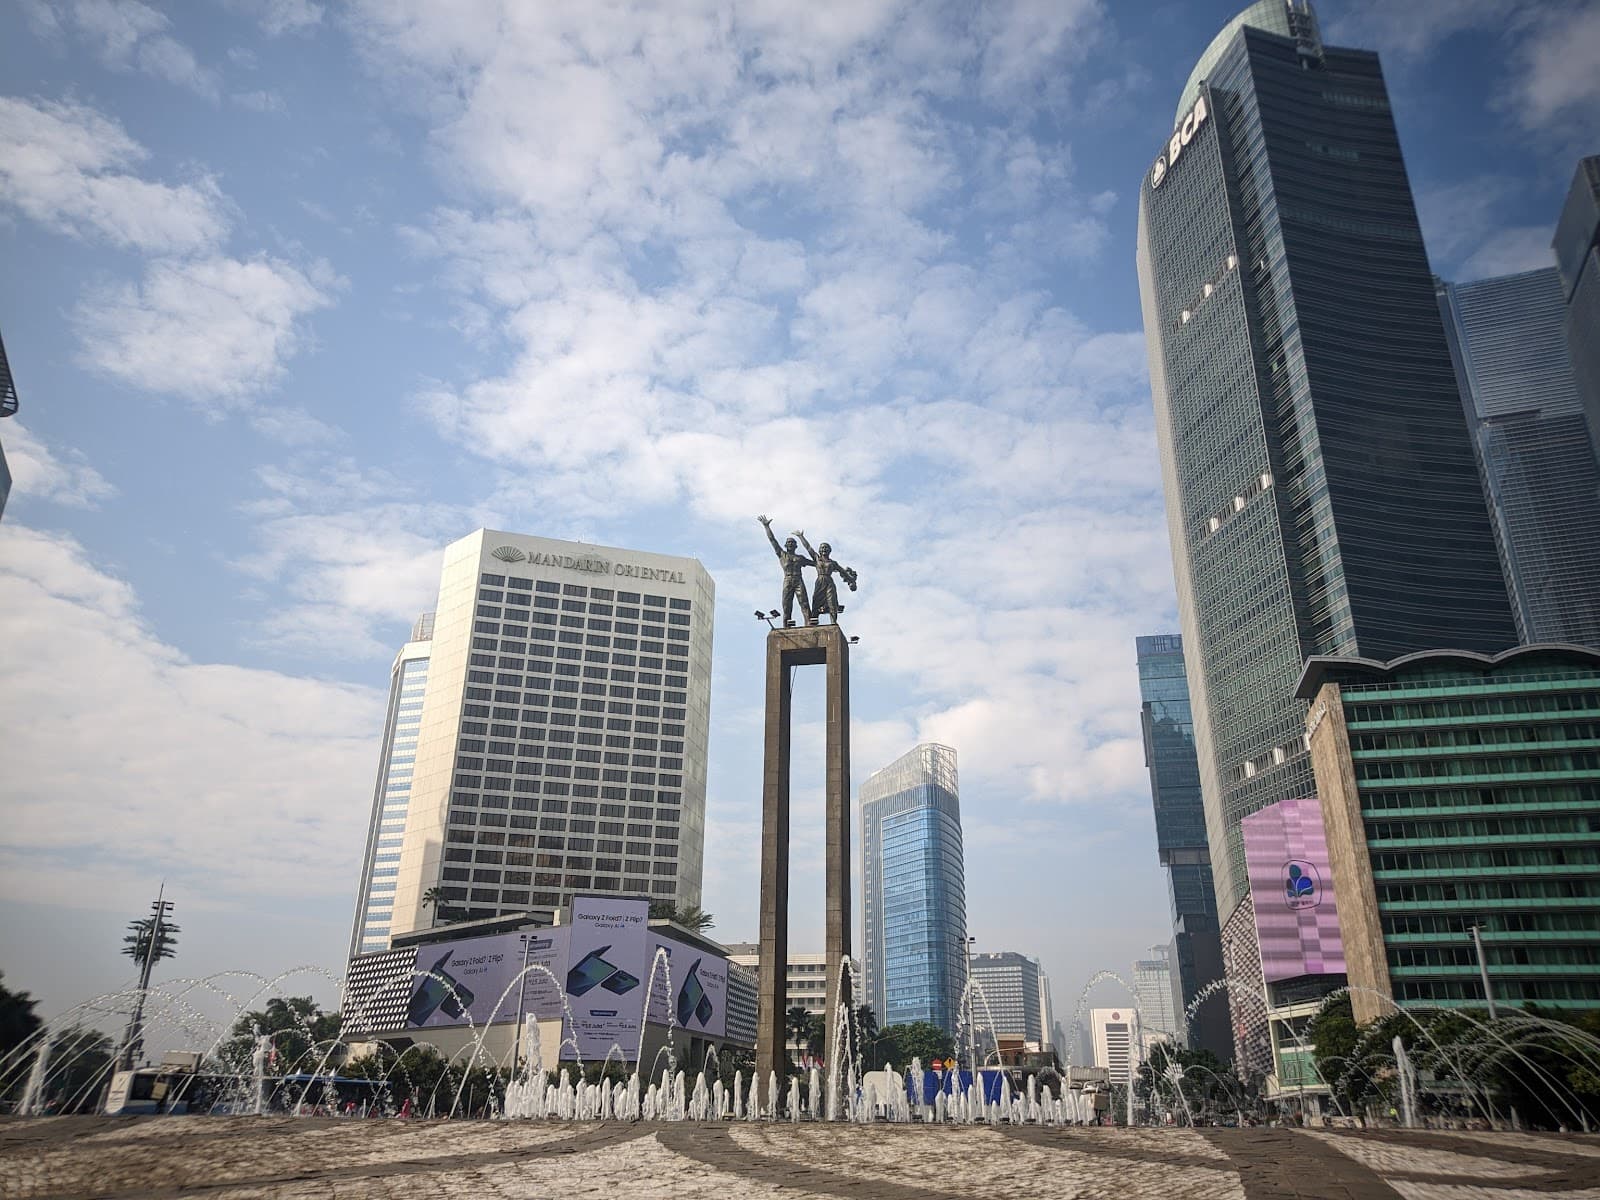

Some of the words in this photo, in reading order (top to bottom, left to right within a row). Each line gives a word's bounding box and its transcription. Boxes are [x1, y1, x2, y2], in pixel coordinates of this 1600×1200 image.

[1169, 96, 1208, 167] BCA
[528, 551, 609, 574] MANDARIN
[614, 563, 686, 584] ORIENTAL
[577, 913, 600, 921] Galaxy
